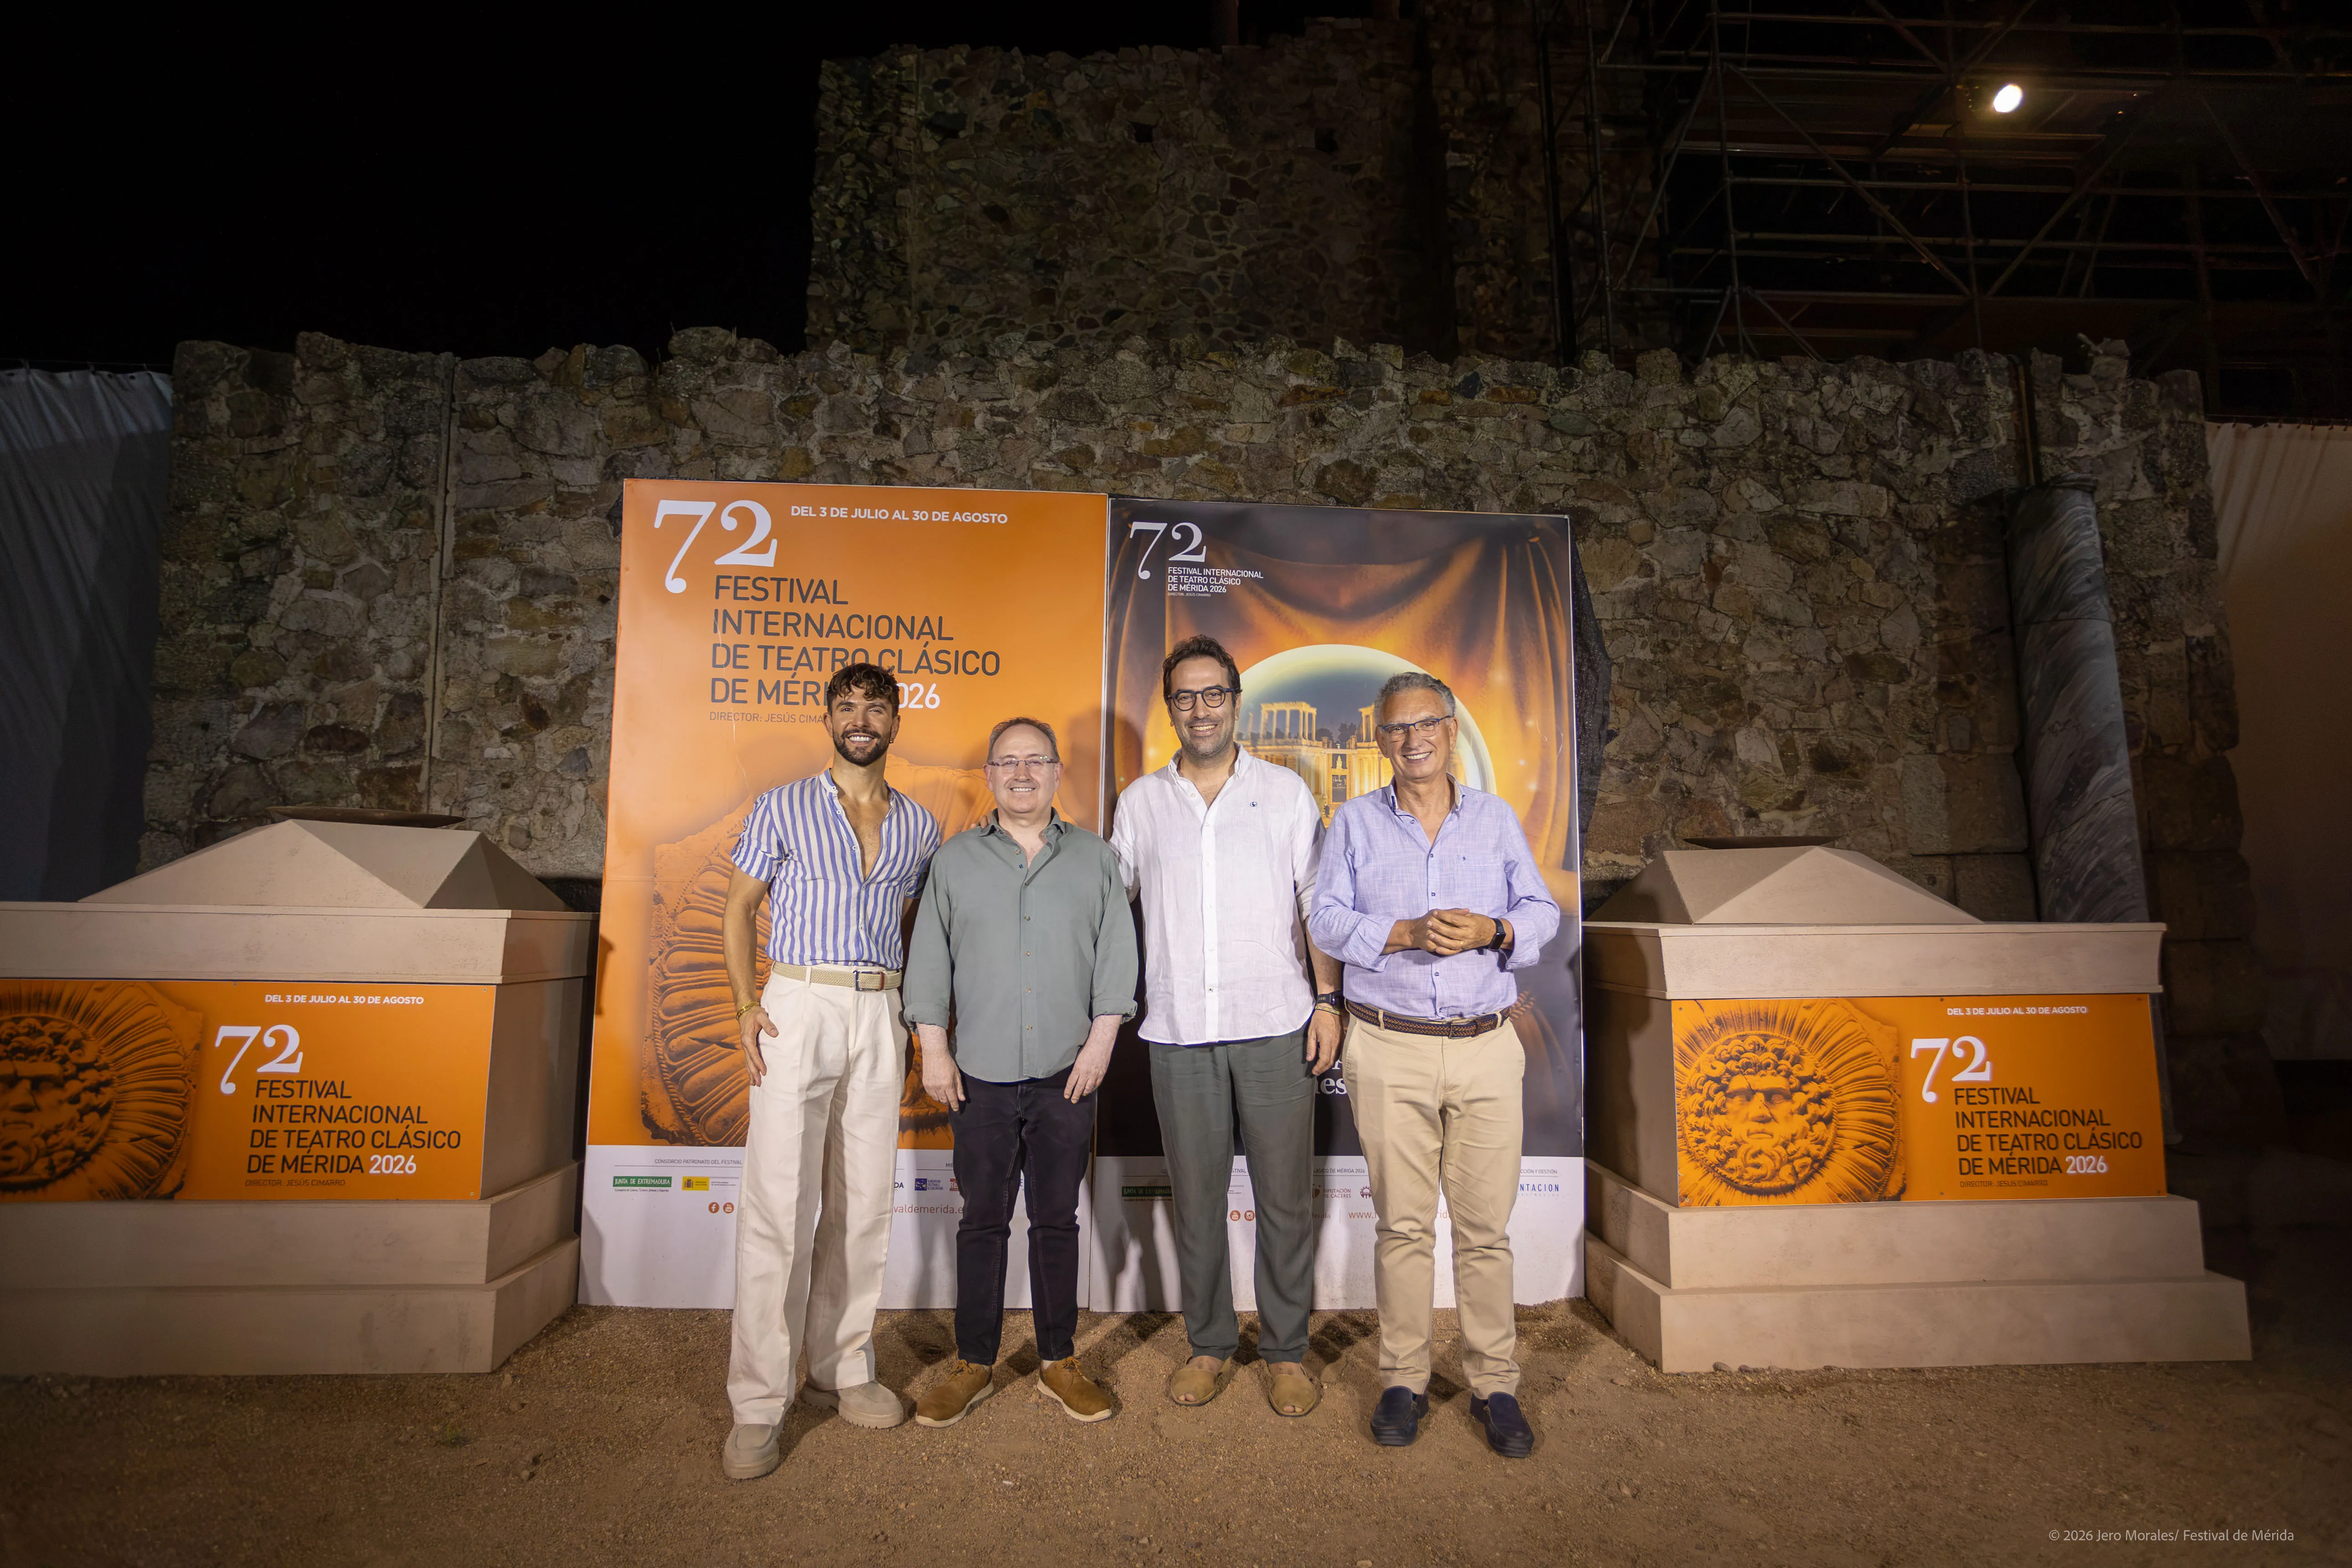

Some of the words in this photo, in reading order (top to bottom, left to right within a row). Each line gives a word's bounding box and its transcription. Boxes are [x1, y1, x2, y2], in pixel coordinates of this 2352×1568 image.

[791, 505, 816, 517] DEL
[820, 506, 827, 517] 3
[830, 507, 848, 518] DE
[851, 508, 889, 520] JULIO
[892, 510, 909, 521] AL
[912, 511, 928, 521] 30
[932, 511, 949, 522] DE
[952, 512, 1008, 524] AGOSTO
[654, 499, 778, 593] 72
[1129, 521, 1207, 579] 72
[1168, 567, 1202, 575] FESTIVAL
[1203, 568, 1264, 578] INTERNACIONAL
[1179, 576, 1208, 584] TEATRO
[1209, 576, 1241, 585] CLÁSICO
[714, 575, 848, 605] FESTIVAL
[1180, 582, 1208, 592] MÉRIDA
[713, 609, 954, 641] INTERNACIONAL
[712, 643, 749, 670] DE
[757, 645, 870, 672] TEATRO
[877, 641, 1000, 676] CLÁSICO
[710, 678, 748, 704] DE
[757, 672, 828, 706] MÉRI
[897, 682, 940, 709] 026
[710, 711, 762, 722] DIRECTOR:
[765, 712, 796, 722] JESÚS
[799, 714, 824, 723] CIMA
[265, 995, 284, 1003] DEL
[285, 995, 292, 1003] 3
[309, 995, 336, 1003] JULIO
[214, 1024, 304, 1095] 72
[1910, 1035, 1993, 1103] 72
[255, 1079, 352, 1099] FESTIVAL
[1954, 1087, 2041, 1105] FESTIVAL
[253, 1104, 428, 1124] INTERNACIONAL
[1955, 1109, 2111, 1128] INTERNACIONAL
[250, 1130, 278, 1148] DE
[283, 1130, 365, 1149] TEATRO
[371, 1124, 461, 1149] CLÁSICO
[1957, 1134, 1982, 1152] DE
[1986, 1133, 2059, 1151] TEATRO
[2063, 1127, 2142, 1150] CLÁSICO
[247, 1155, 276, 1173] DE
[281, 1146, 364, 1174] MÉRIDA
[369, 1154, 417, 1174] 2026
[1958, 1157, 1984, 1176] DE
[1988, 1150, 2063, 1175] MÉRIDA
[2065, 1155, 2108, 1175] 2026
[894, 1204, 963, 1214] valdemerida.e
